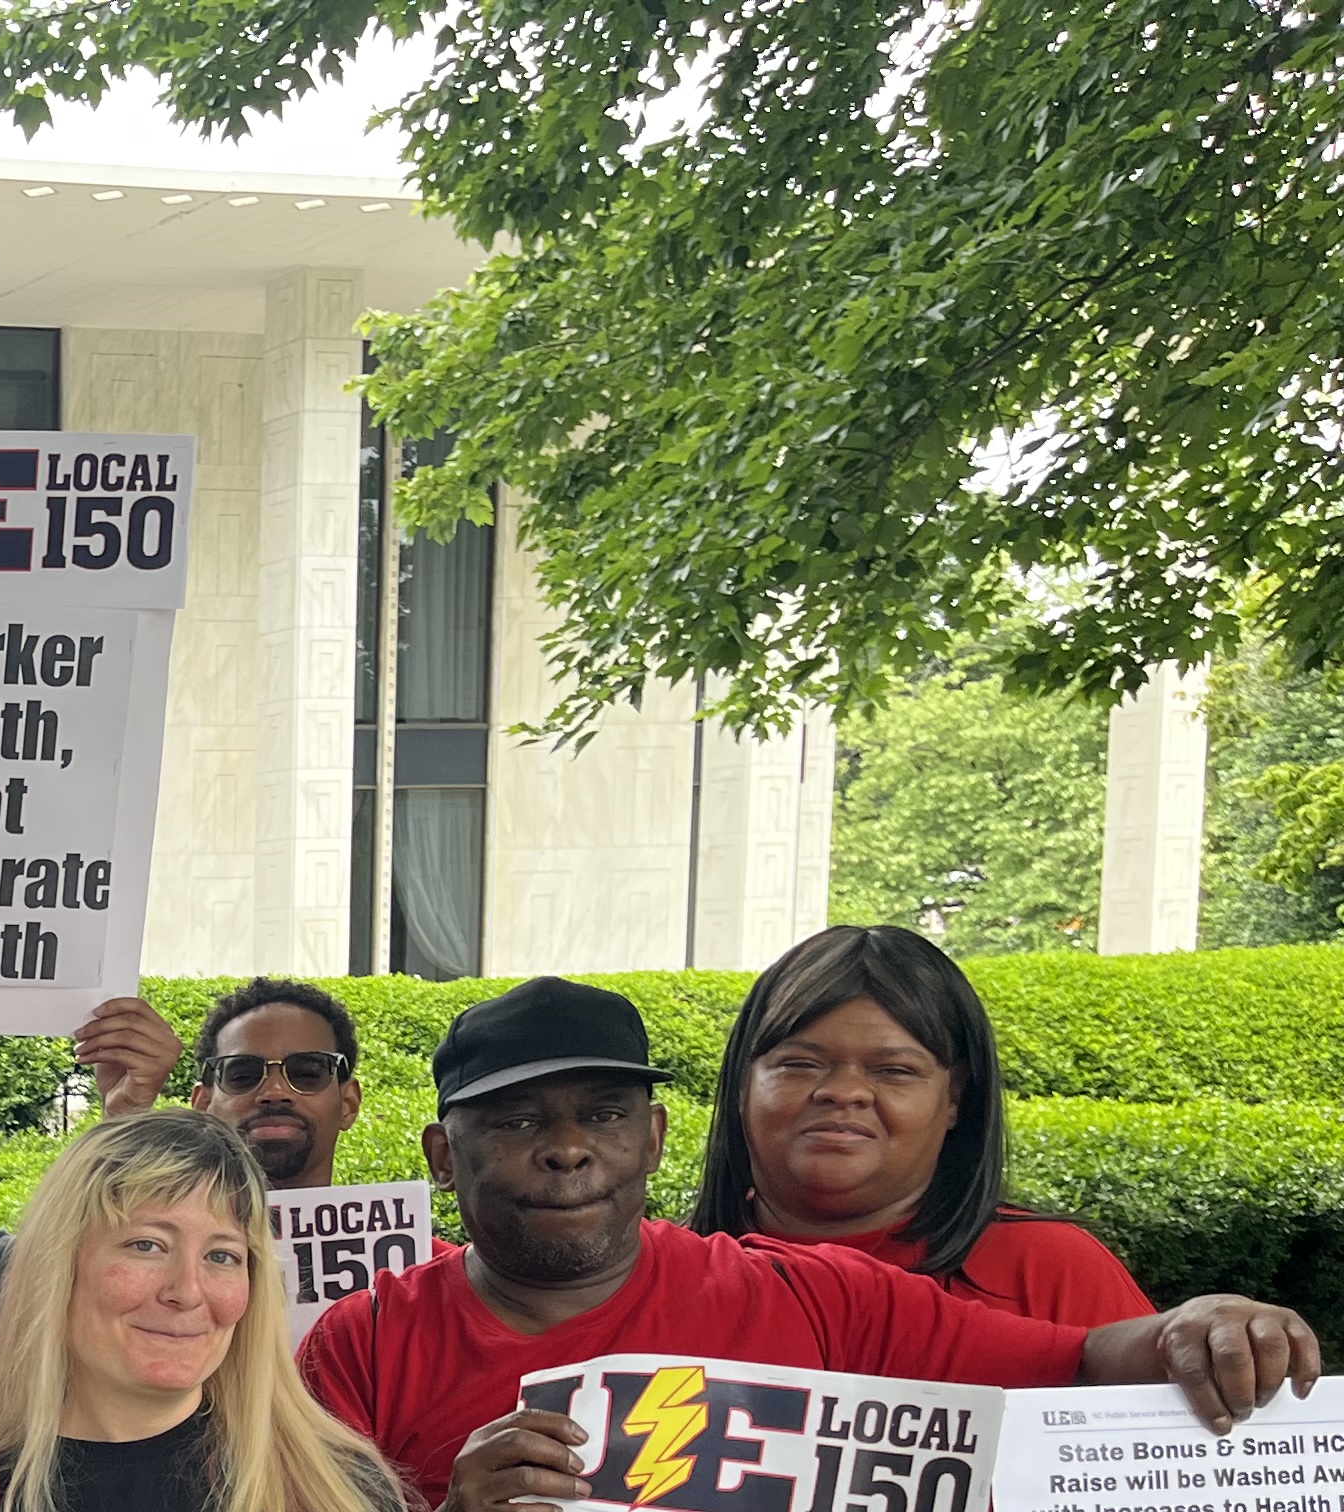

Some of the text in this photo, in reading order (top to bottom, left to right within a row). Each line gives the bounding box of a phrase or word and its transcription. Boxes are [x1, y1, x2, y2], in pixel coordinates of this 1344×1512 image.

[46, 453, 177, 493] LOCAL
[42, 496, 175, 570] 150
[289, 1198, 414, 1238] LOCAL
[293, 1234, 416, 1304] 150
[816, 1395, 978, 1452] LOCAL
[1058, 1435, 1304, 1462] State Bonus & Small
[1049, 1464, 1304, 1493] Raise will be Washed
